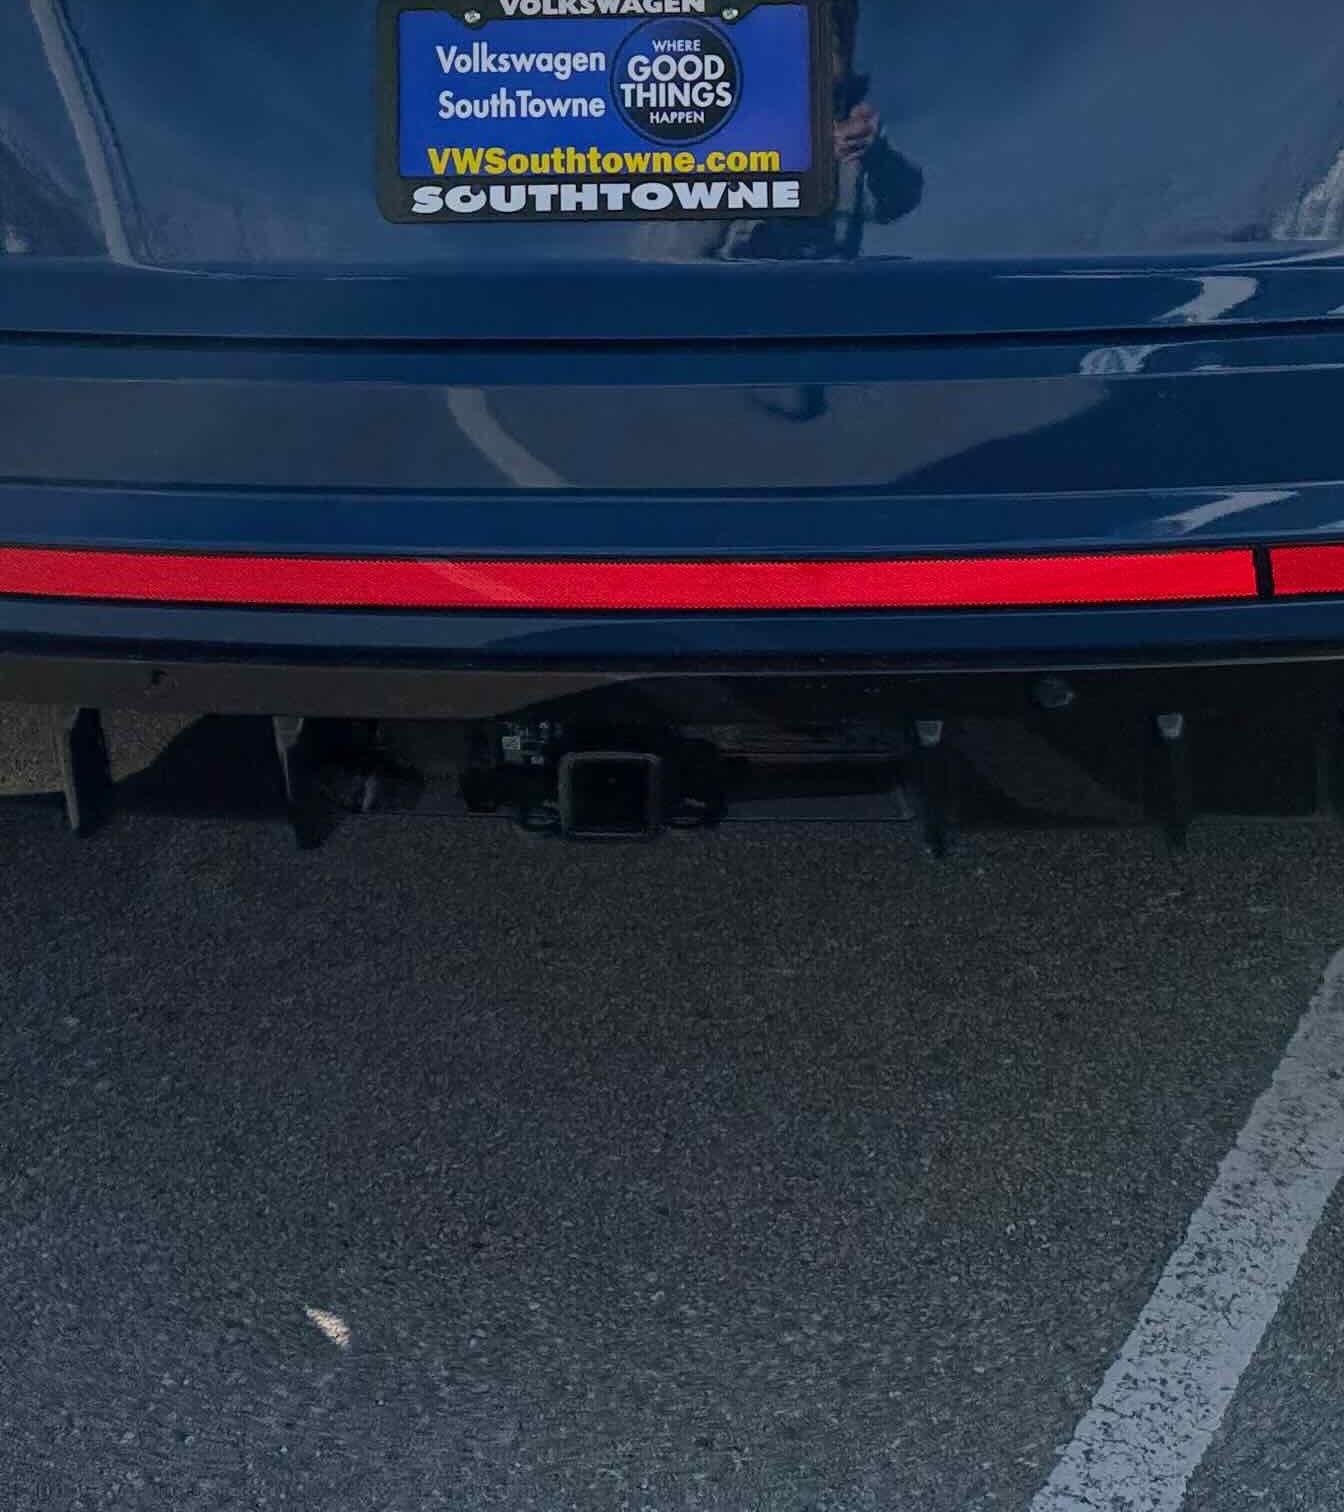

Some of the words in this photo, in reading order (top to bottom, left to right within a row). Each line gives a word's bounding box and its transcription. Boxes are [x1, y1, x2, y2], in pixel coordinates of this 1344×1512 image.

[652, 39, 701, 53] WHERE
[436, 42, 606, 80] Volkswagen
[627, 55, 725, 83] GOOD
[438, 88, 606, 120] SouthTowne
[620, 82, 733, 109] THINGS
[649, 111, 705, 125] HAPPEN
[428, 148, 780, 175] VWSouthtowne.com
[411, 181, 800, 214] SOUTHTOWNE
